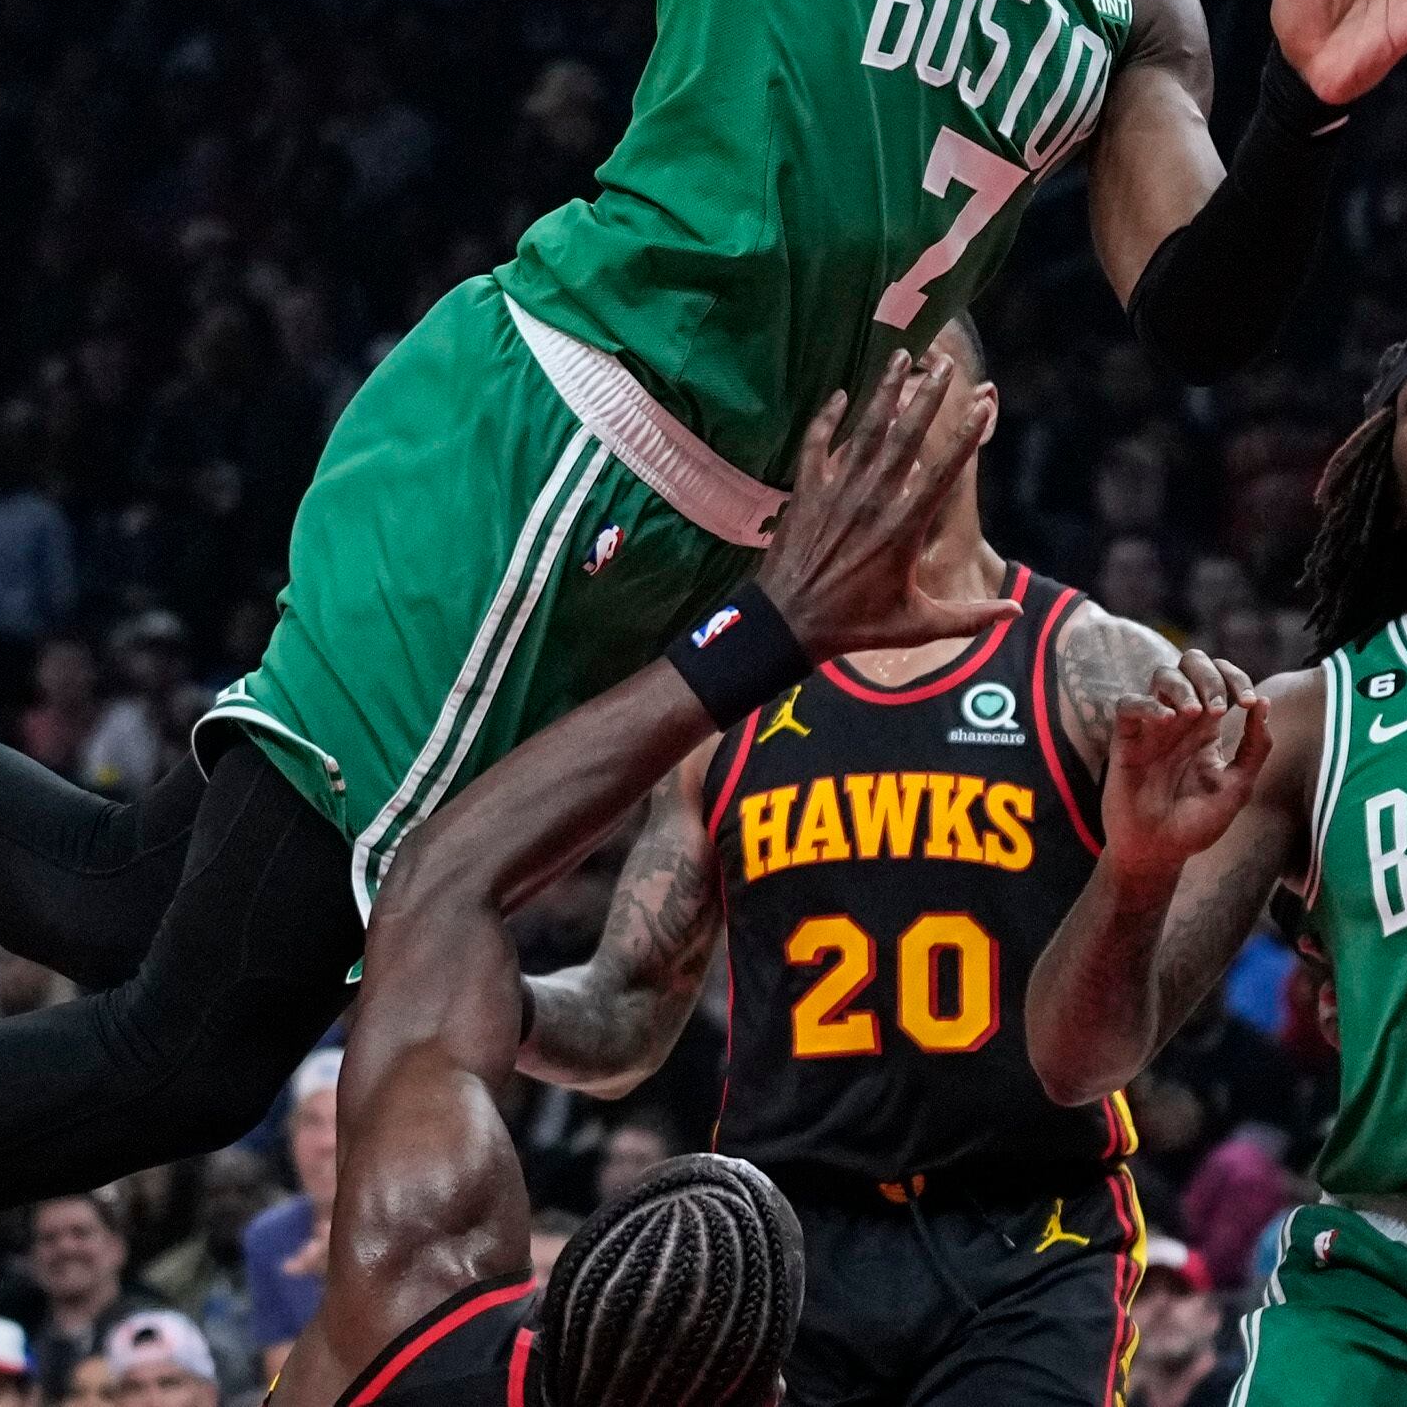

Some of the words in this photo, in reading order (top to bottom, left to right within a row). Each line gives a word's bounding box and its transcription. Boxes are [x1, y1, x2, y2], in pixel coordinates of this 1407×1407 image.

[873, 125, 1030, 330] 7
[949, 729, 1026, 745] sharecare
[1368, 673, 1396, 698] 6
[738, 771, 1036, 884] HAWKS
[784, 910, 1001, 1059] 20
